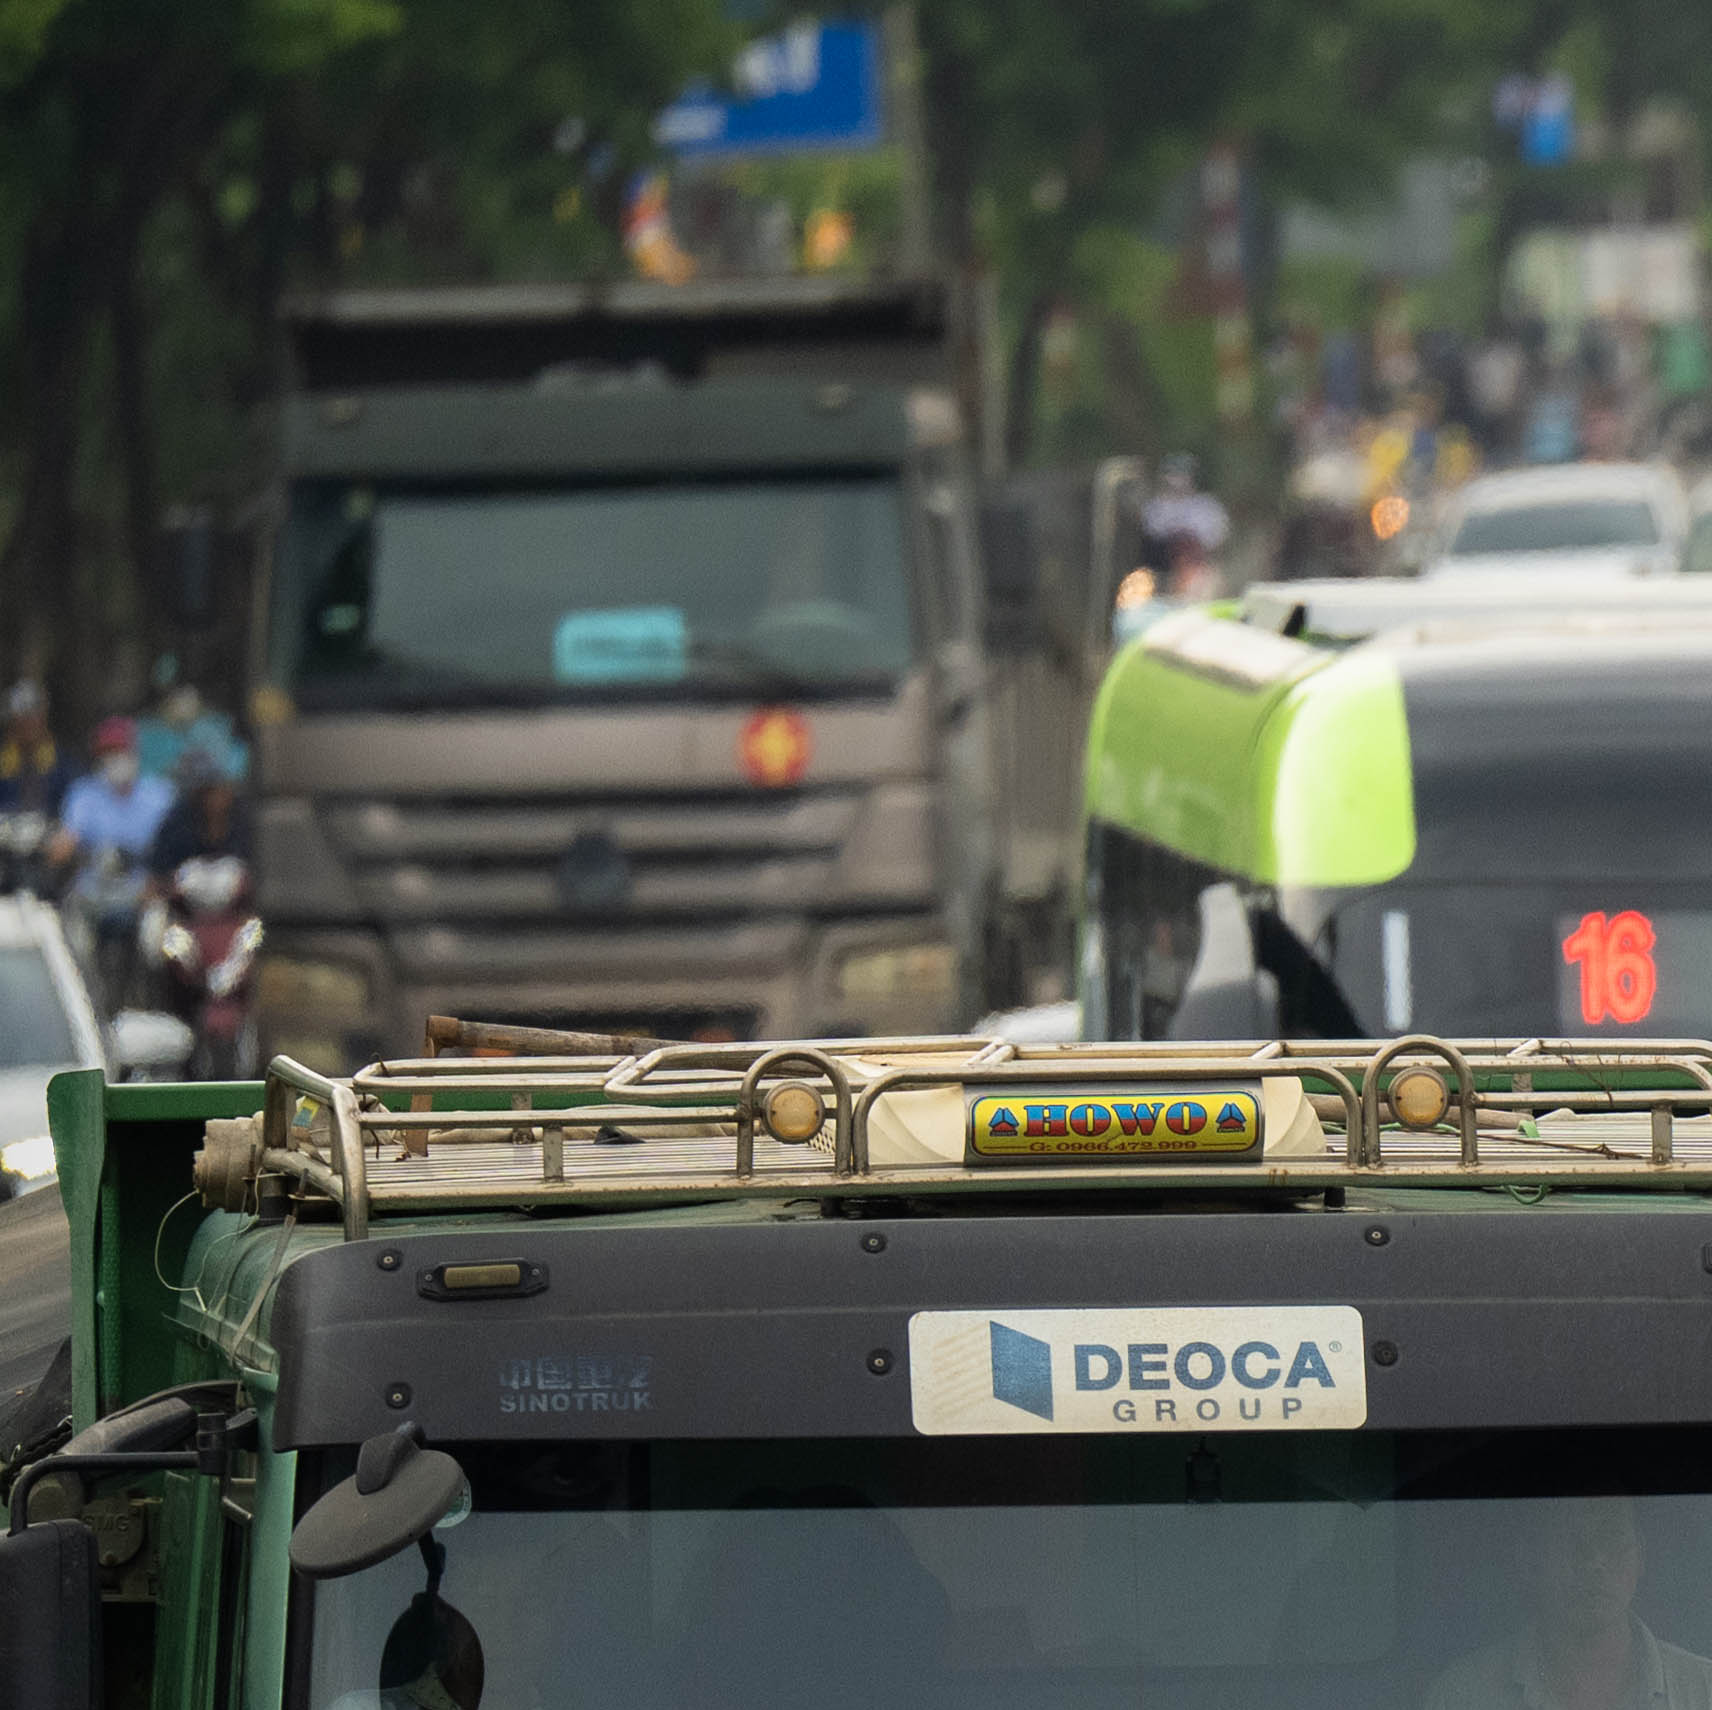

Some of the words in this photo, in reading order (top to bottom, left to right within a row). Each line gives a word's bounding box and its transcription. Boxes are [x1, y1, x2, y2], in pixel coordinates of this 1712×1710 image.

[1562, 910, 1656, 1024] 16
[1023, 1101, 1208, 1137] HOWO
[1073, 1341, 1337, 1391] DEOCA
[500, 1391, 651, 1414] SINOTRUK
[1112, 1398, 1303, 1423] GROUP
